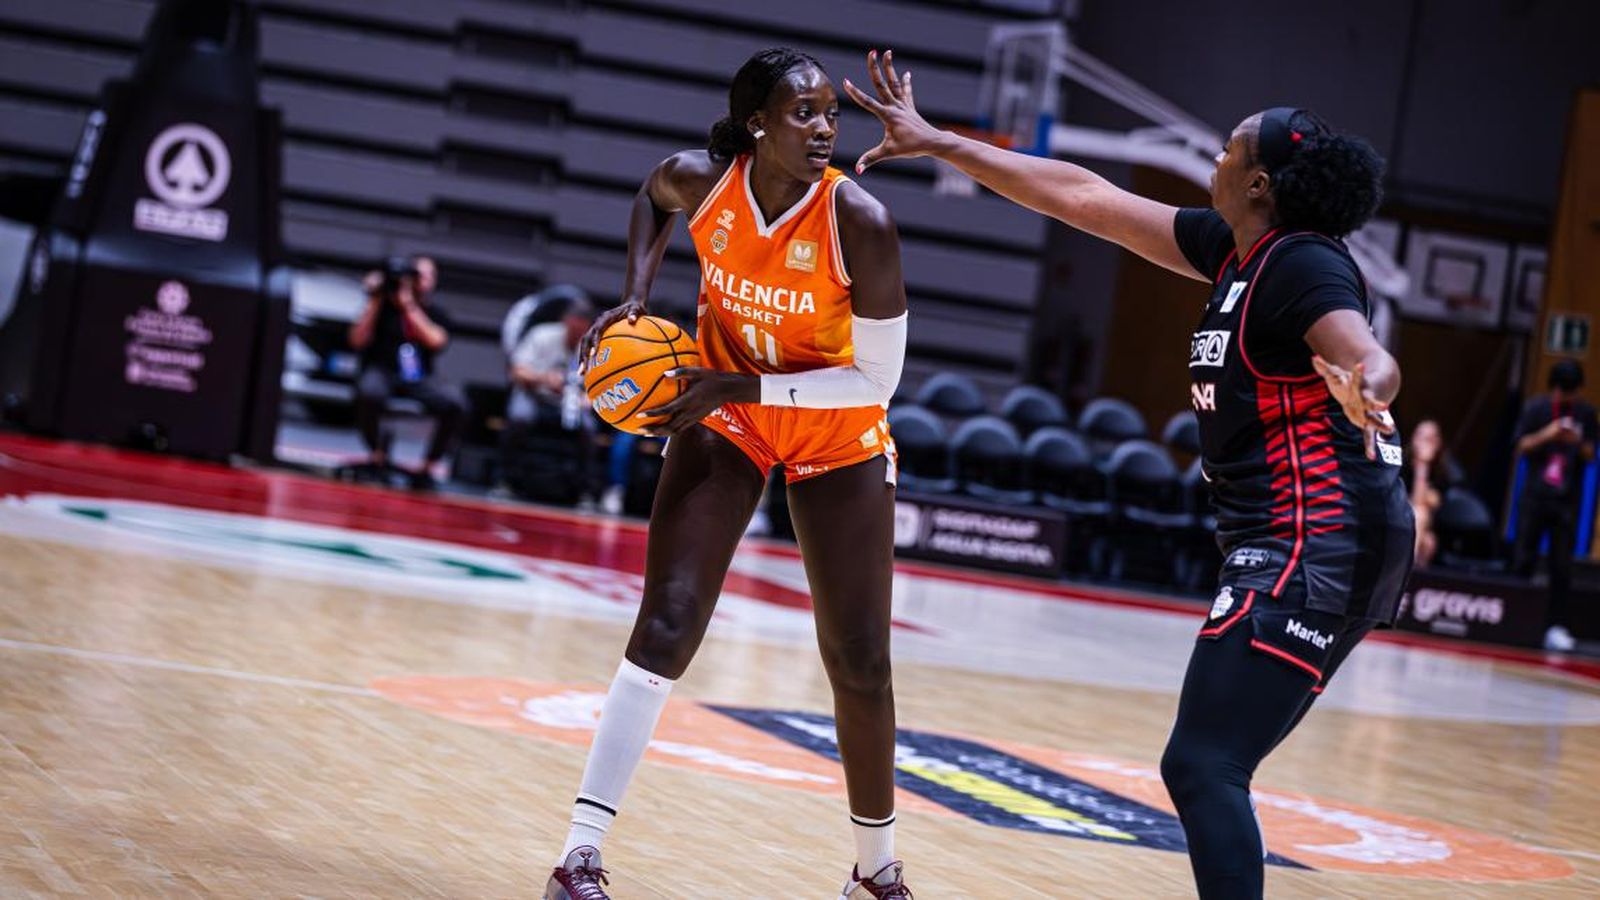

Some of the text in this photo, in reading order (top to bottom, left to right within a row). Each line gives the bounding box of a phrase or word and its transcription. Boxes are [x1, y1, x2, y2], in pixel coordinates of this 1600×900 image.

[703, 255, 816, 314] VALENCIA
[722, 297, 784, 326] BASKET
[742, 324, 779, 367] 11
